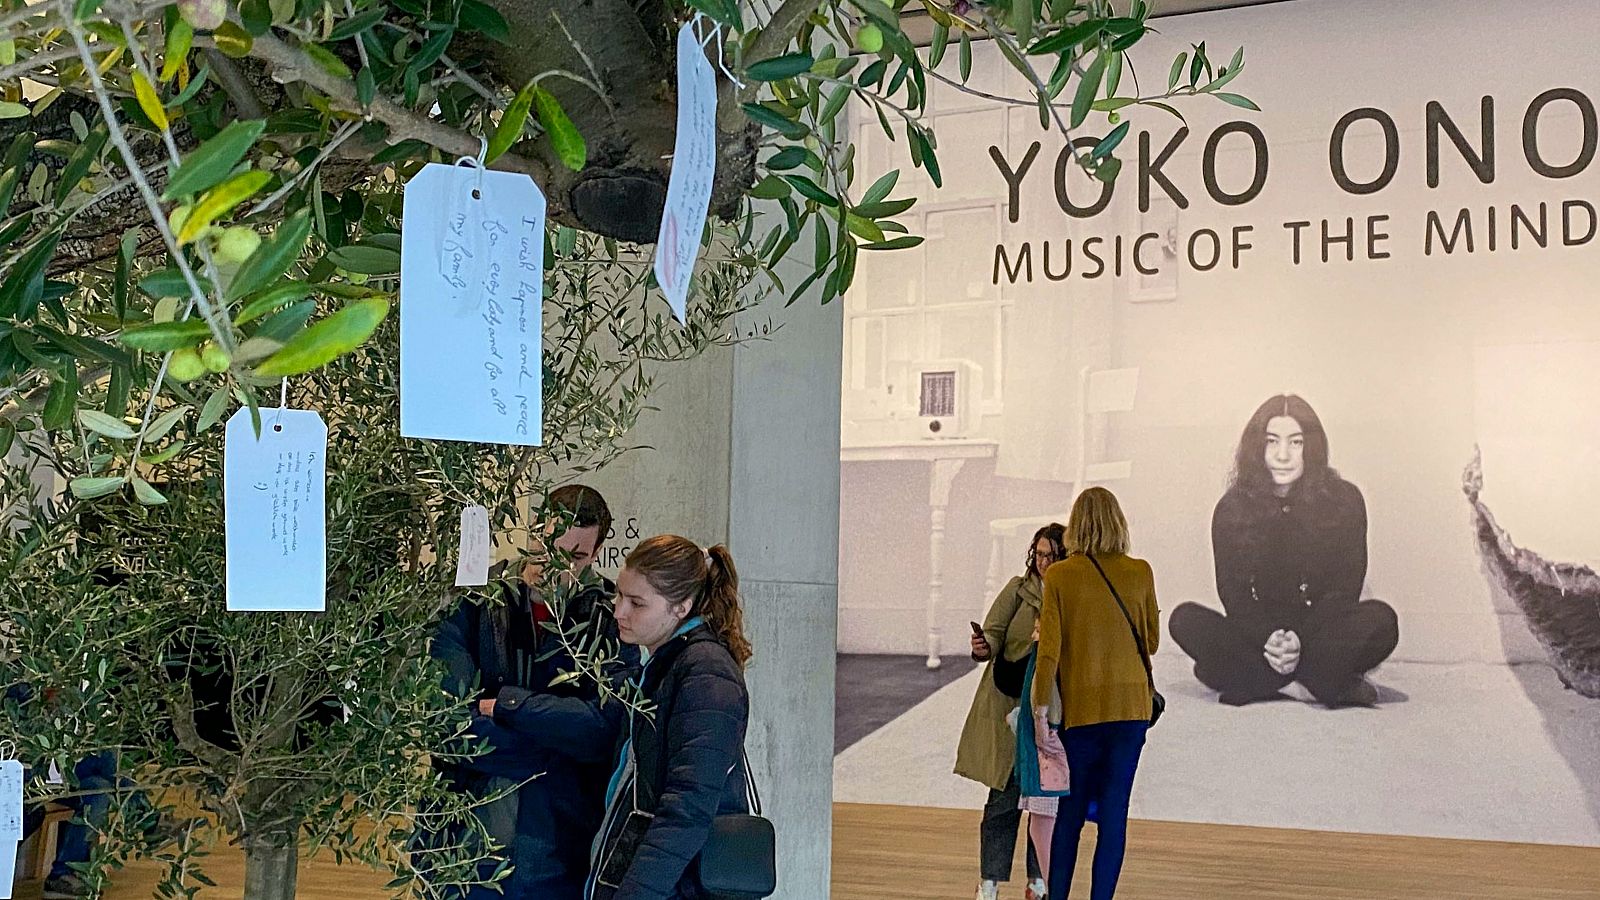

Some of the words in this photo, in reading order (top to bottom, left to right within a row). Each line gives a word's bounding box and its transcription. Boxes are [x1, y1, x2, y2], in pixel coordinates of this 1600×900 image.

[989, 120, 1268, 224] YOKO
[1329, 87, 1599, 195] ONO
[449, 213, 467, 237] my
[482, 220, 508, 247] for
[992, 233, 1161, 284] MUSIC
[1187, 226, 1254, 271] OF
[1283, 214, 1391, 265] THE
[1424, 199, 1598, 256] MIND
[519, 237, 536, 271] wish
[487, 327, 504, 360] and
[519, 343, 533, 388] and
[490, 388, 507, 416] all
[514, 395, 528, 435] peace
[625, 517, 640, 539] &
